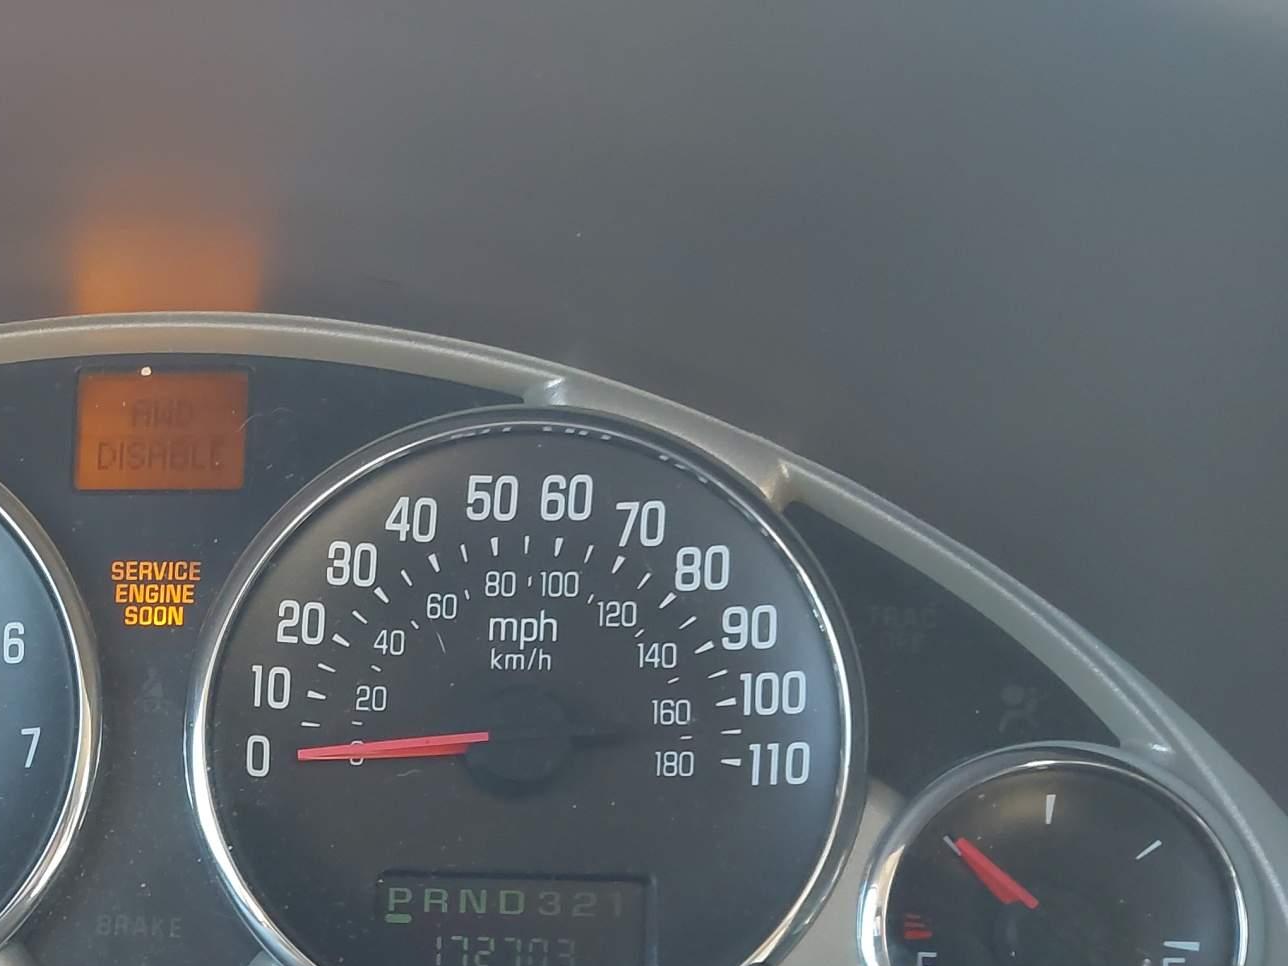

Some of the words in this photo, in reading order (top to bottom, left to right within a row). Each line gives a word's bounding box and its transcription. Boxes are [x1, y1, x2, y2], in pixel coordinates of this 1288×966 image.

[466, 474, 520, 522] 50
[540, 474, 594, 521] 60
[384, 496, 439, 543] 40
[615, 500, 666, 548] 70
[111, 561, 201, 581] SERVICE
[326, 541, 378, 587] 30
[674, 544, 730, 592] 80
[115, 583, 195, 604] ENGINE
[484, 570, 517, 597] 80
[540, 570, 580, 598] 100
[124, 605, 184, 626] SOON
[276, 600, 326, 646] 20
[426, 592, 458, 620] 60
[596, 600, 637, 628] 120
[2, 621, 25, 665] 6
[373, 629, 405, 656] 40
[488, 611, 558, 645] mph
[721, 604, 778, 650] 90
[490, 647, 552, 671] km/h
[637, 642, 678, 669] 140
[250, 664, 292, 710] 10
[355, 685, 388, 711] 20
[739, 670, 807, 716] 100
[651, 699, 692, 726] 160
[19, 726, 42, 769] 7
[246, 734, 271, 778] 0
[654, 750, 696, 777] 180
[748, 741, 811, 787] 110
[96, 914, 182, 938] BRAKE
